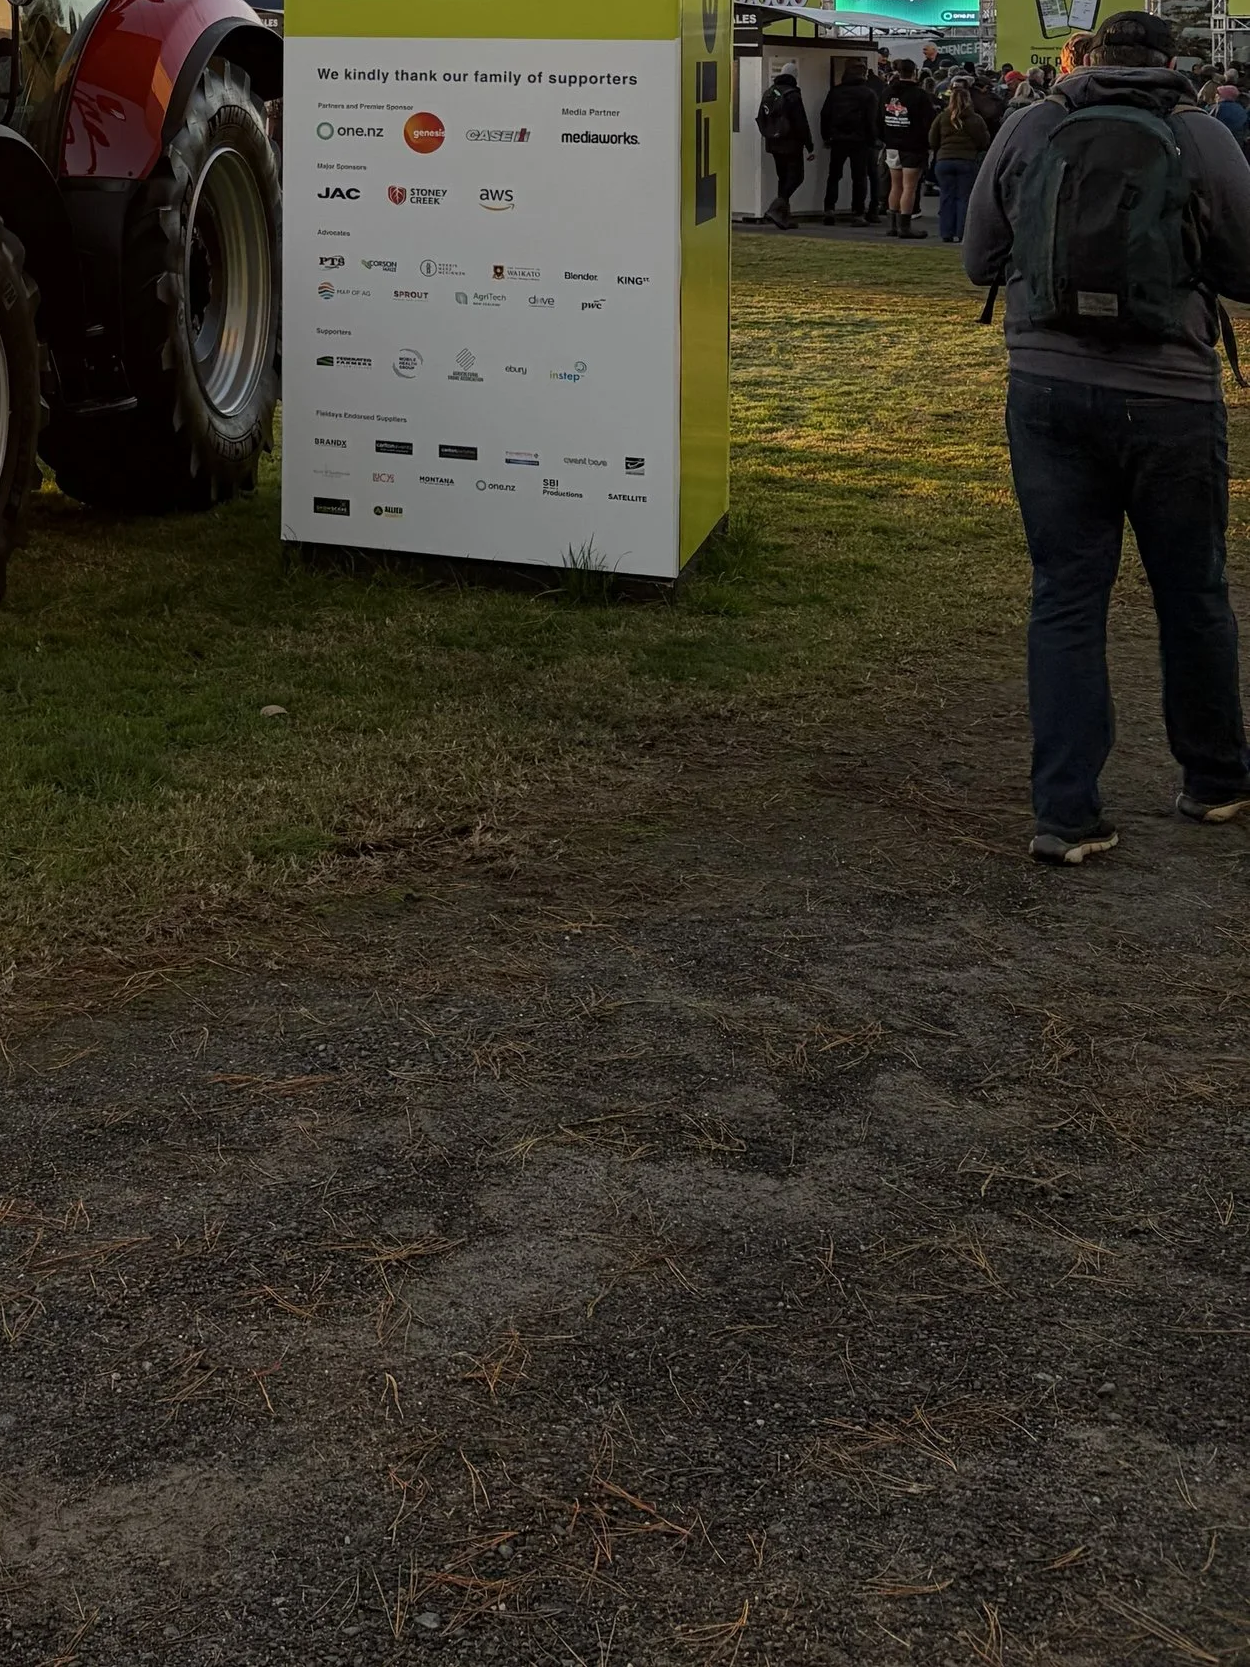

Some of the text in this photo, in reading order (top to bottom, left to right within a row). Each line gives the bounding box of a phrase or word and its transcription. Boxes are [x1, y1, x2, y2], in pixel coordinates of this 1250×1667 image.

[261, 18, 279, 28] LES
[734, 14, 757, 24] LES
[1031, 54, 1052, 65] Our
[317, 68, 638, 87] We kindly thank our family of supporters
[561, 108, 620, 117] Media Partner
[337, 126, 384, 138] one.nz
[413, 129, 445, 139] genesis
[466, 130, 514, 142] CASE
[317, 187, 361, 200] JAC
[410, 188, 448, 197] STONEY
[479, 188, 514, 202] aws
[369, 259, 398, 268] CORSON
[507, 270, 541, 278] WAIKATO
[393, 290, 429, 299] SPROUT
[473, 292, 507, 302] AgriTech
[581, 300, 603, 311] pwc
[505, 364, 527, 375] ebury
[550, 370, 580, 383] instep
[419, 475, 455, 484] MONTANA
[543, 479, 559, 487] SBI
[488, 483, 516, 492] one.nz
[543, 489, 583, 499] Productions
[607, 493, 648, 503] SATELLITE
